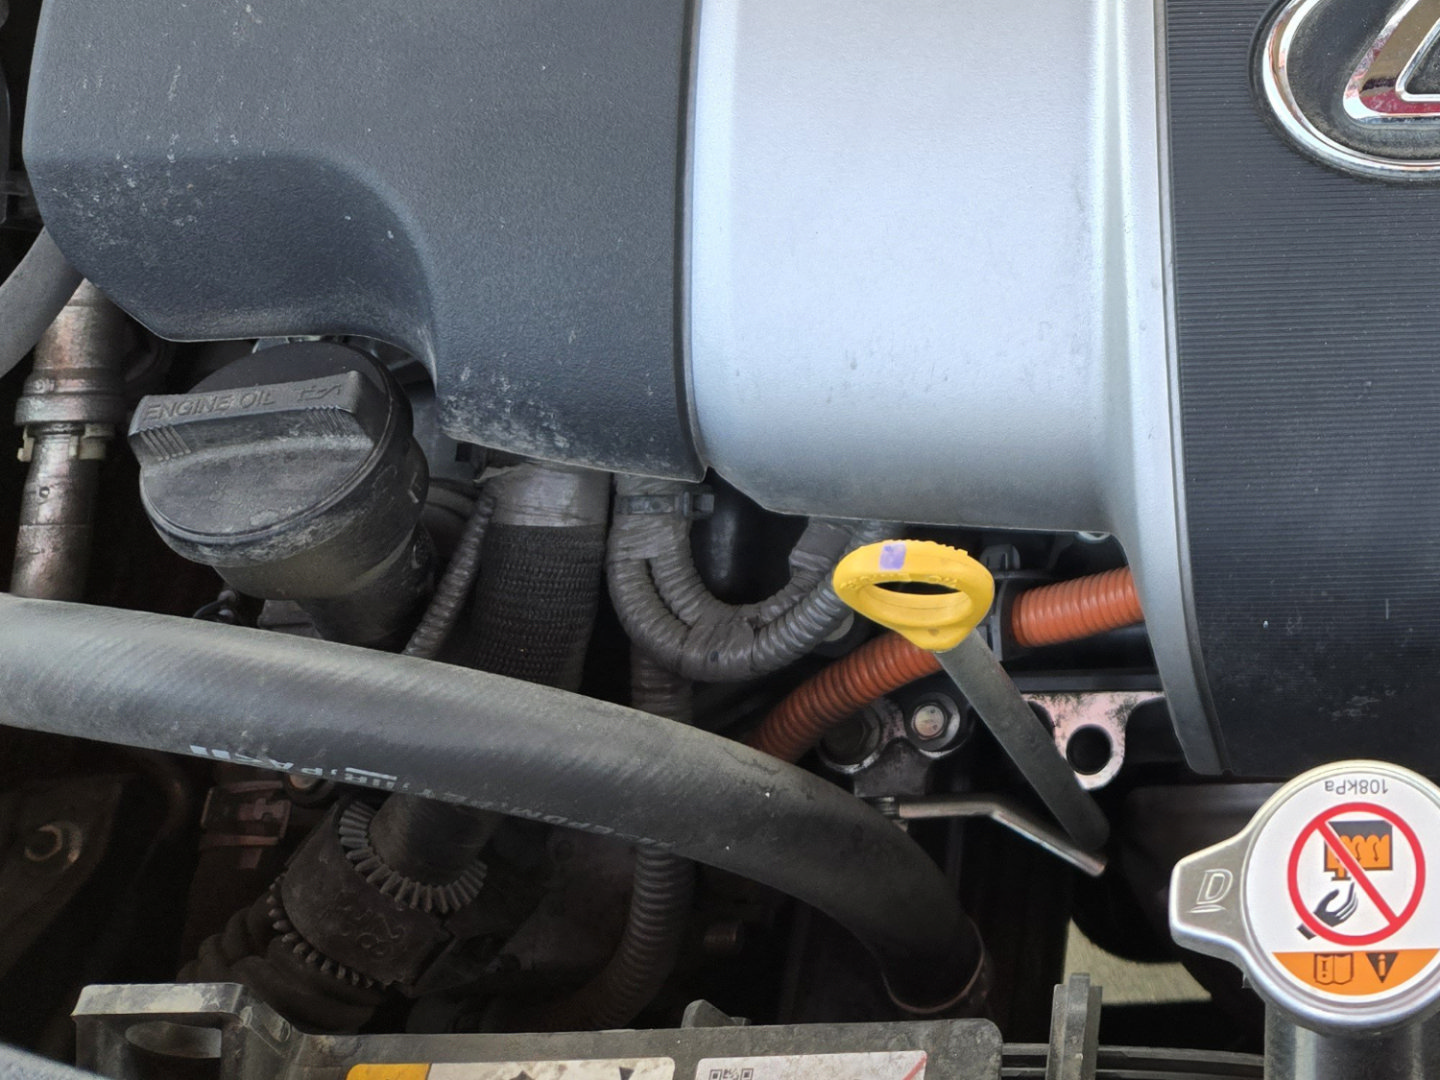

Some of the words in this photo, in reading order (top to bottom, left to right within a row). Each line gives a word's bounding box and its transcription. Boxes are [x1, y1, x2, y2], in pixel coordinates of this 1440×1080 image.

[144, 394, 233, 421] ENGINE
[240, 389, 275, 409] OIL
[1324, 778, 1389, 796] 108kPa
